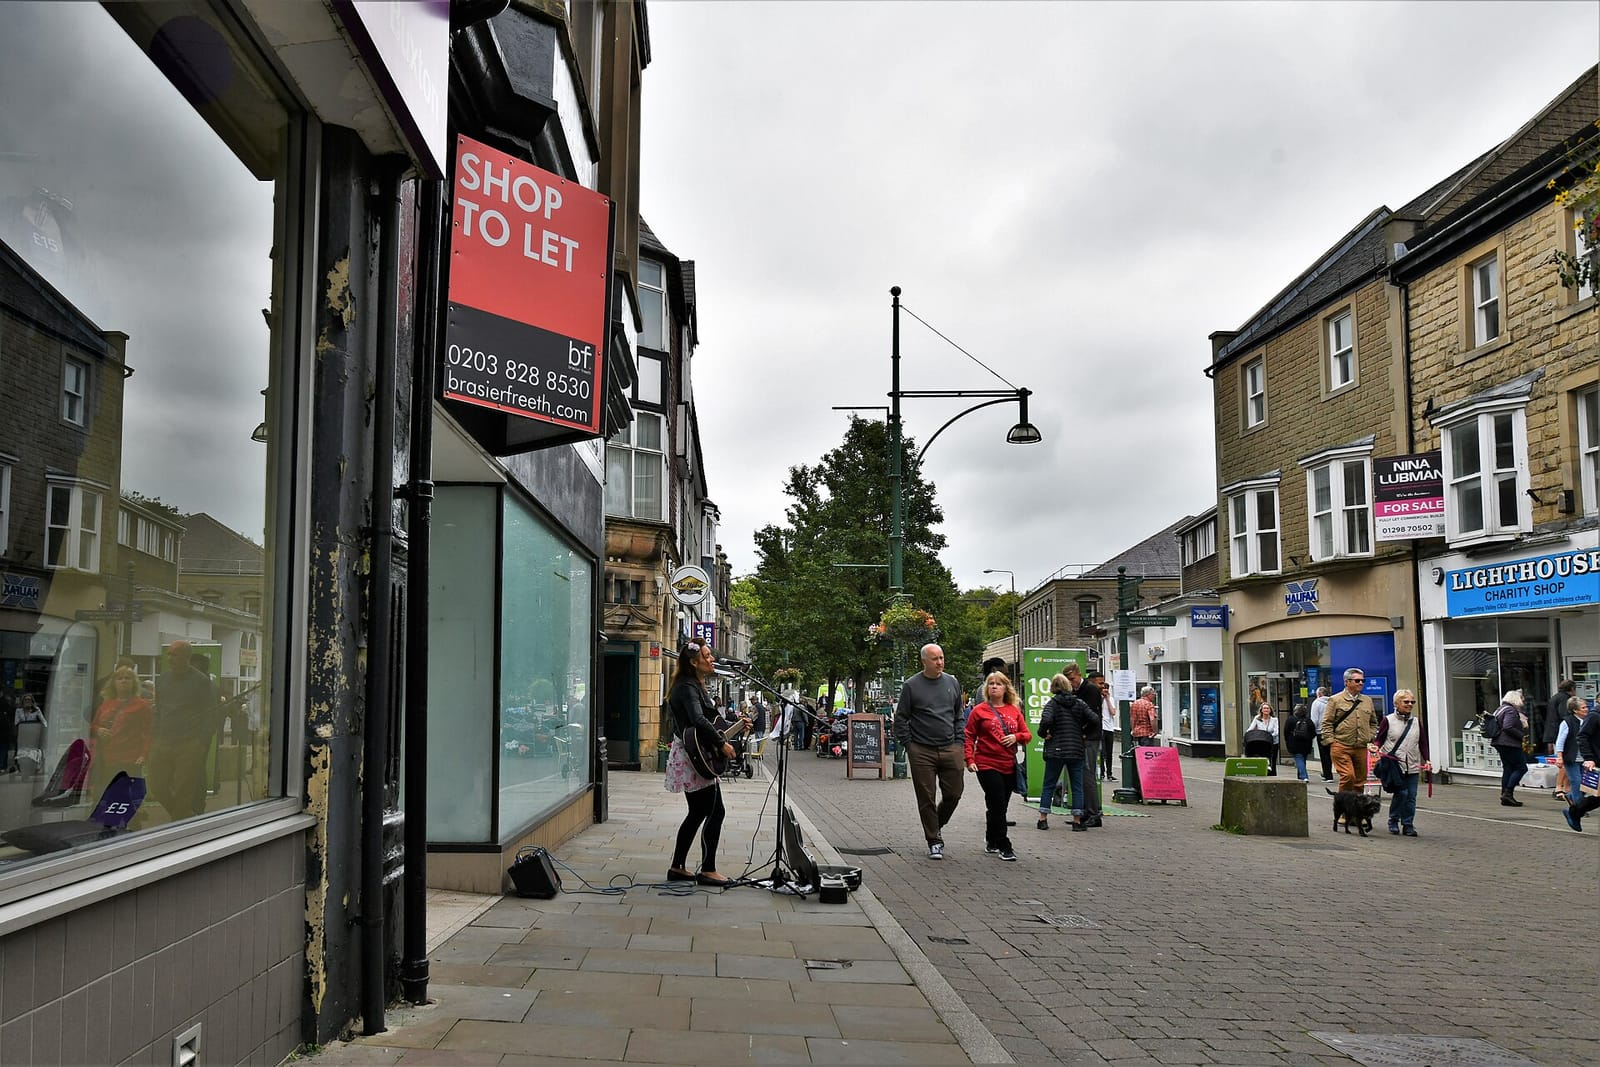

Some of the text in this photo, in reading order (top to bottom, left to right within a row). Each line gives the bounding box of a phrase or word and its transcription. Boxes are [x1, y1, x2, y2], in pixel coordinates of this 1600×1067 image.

[459, 152, 563, 220] SHOP
[457, 197, 580, 273] TO LET
[448, 344, 590, 399] 0203 828 8530
[447, 369, 588, 423] brasierfreeth.com
[1392, 458, 1431, 472] NINA
[1379, 469, 1444, 485] LUBMAN
[1383, 500, 1444, 514] FOR SALE
[1382, 524, 1433, 534] 01298 70502
[1451, 551, 1599, 592] LIGHTHOUSE
[1285, 590, 1318, 604] HALIFAX
[1485, 581, 1565, 602] CHARITY SHOP
[1574, 594, 1592, 602] charity
[105, 802, 130, 815] £5
